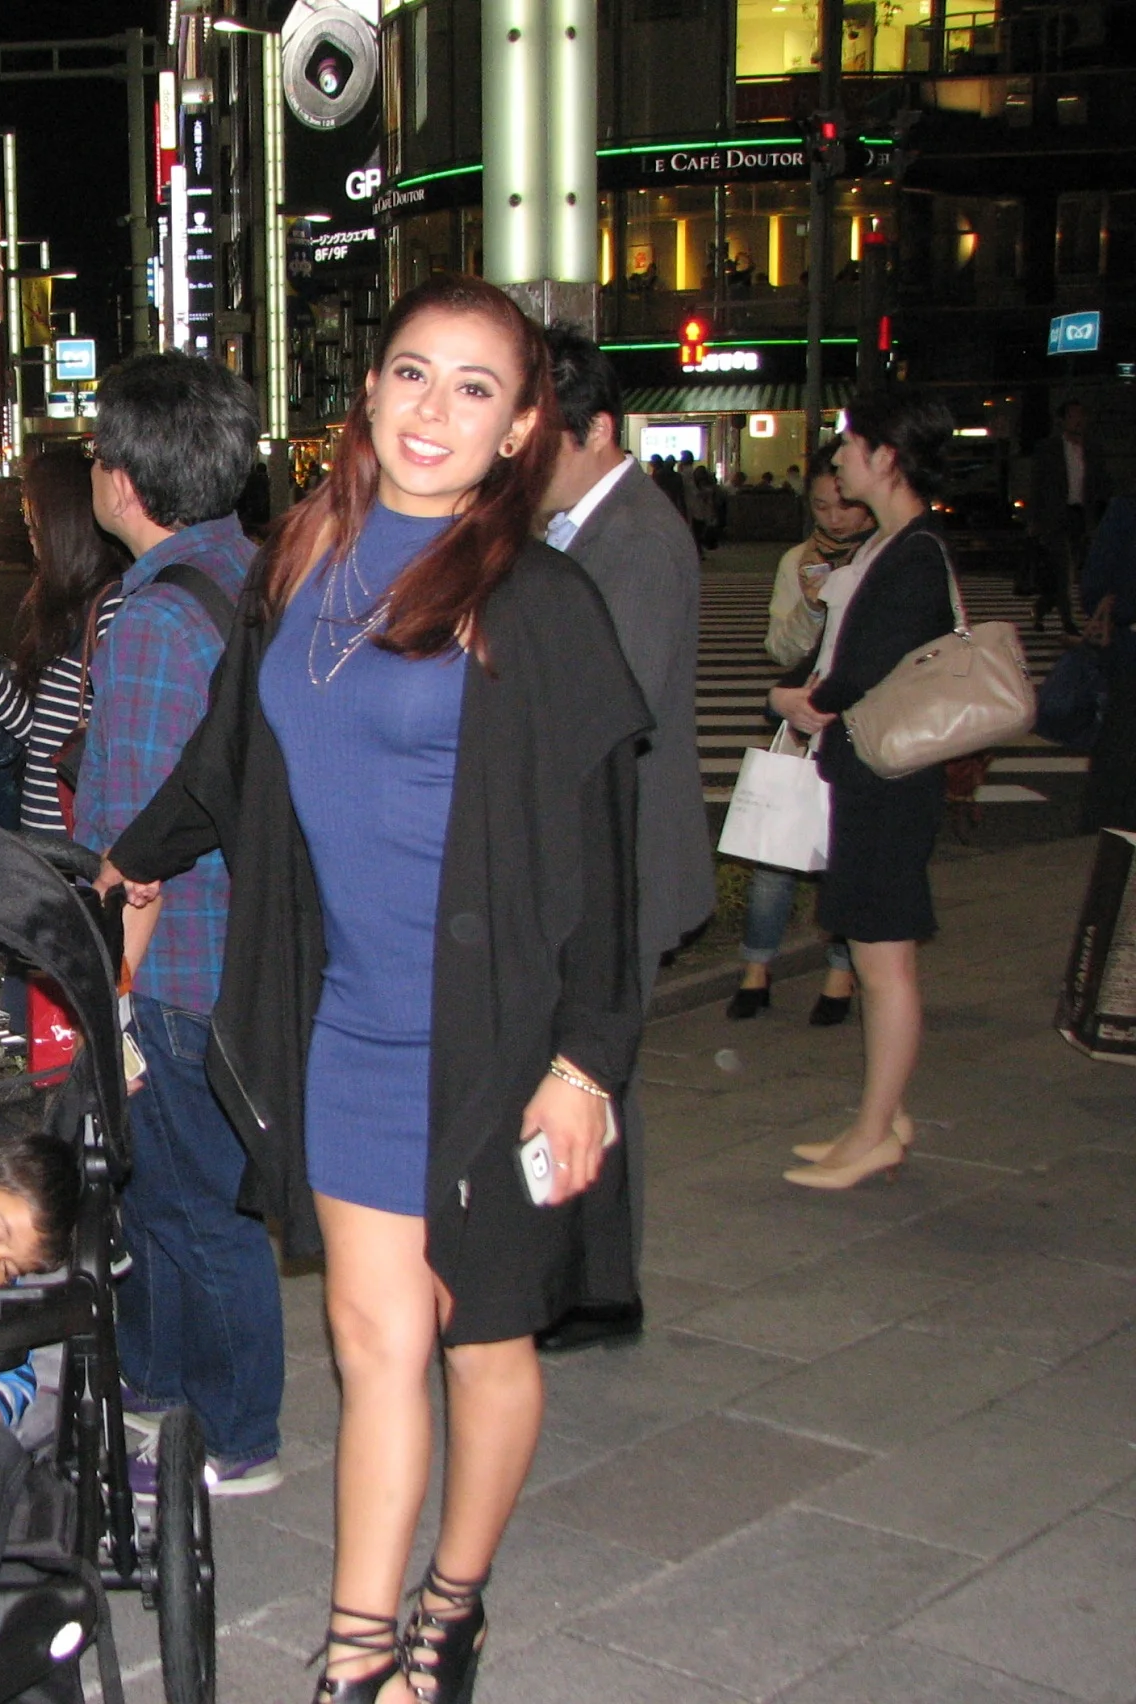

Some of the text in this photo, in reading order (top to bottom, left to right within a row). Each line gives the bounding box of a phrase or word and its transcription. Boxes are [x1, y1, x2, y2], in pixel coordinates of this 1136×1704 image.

[670, 152, 720, 172] CAFÉ
[726, 149, 803, 168] DOUTOR
[392, 188, 425, 207] DOUTOR
[314, 245, 348, 263] 8F/9F
